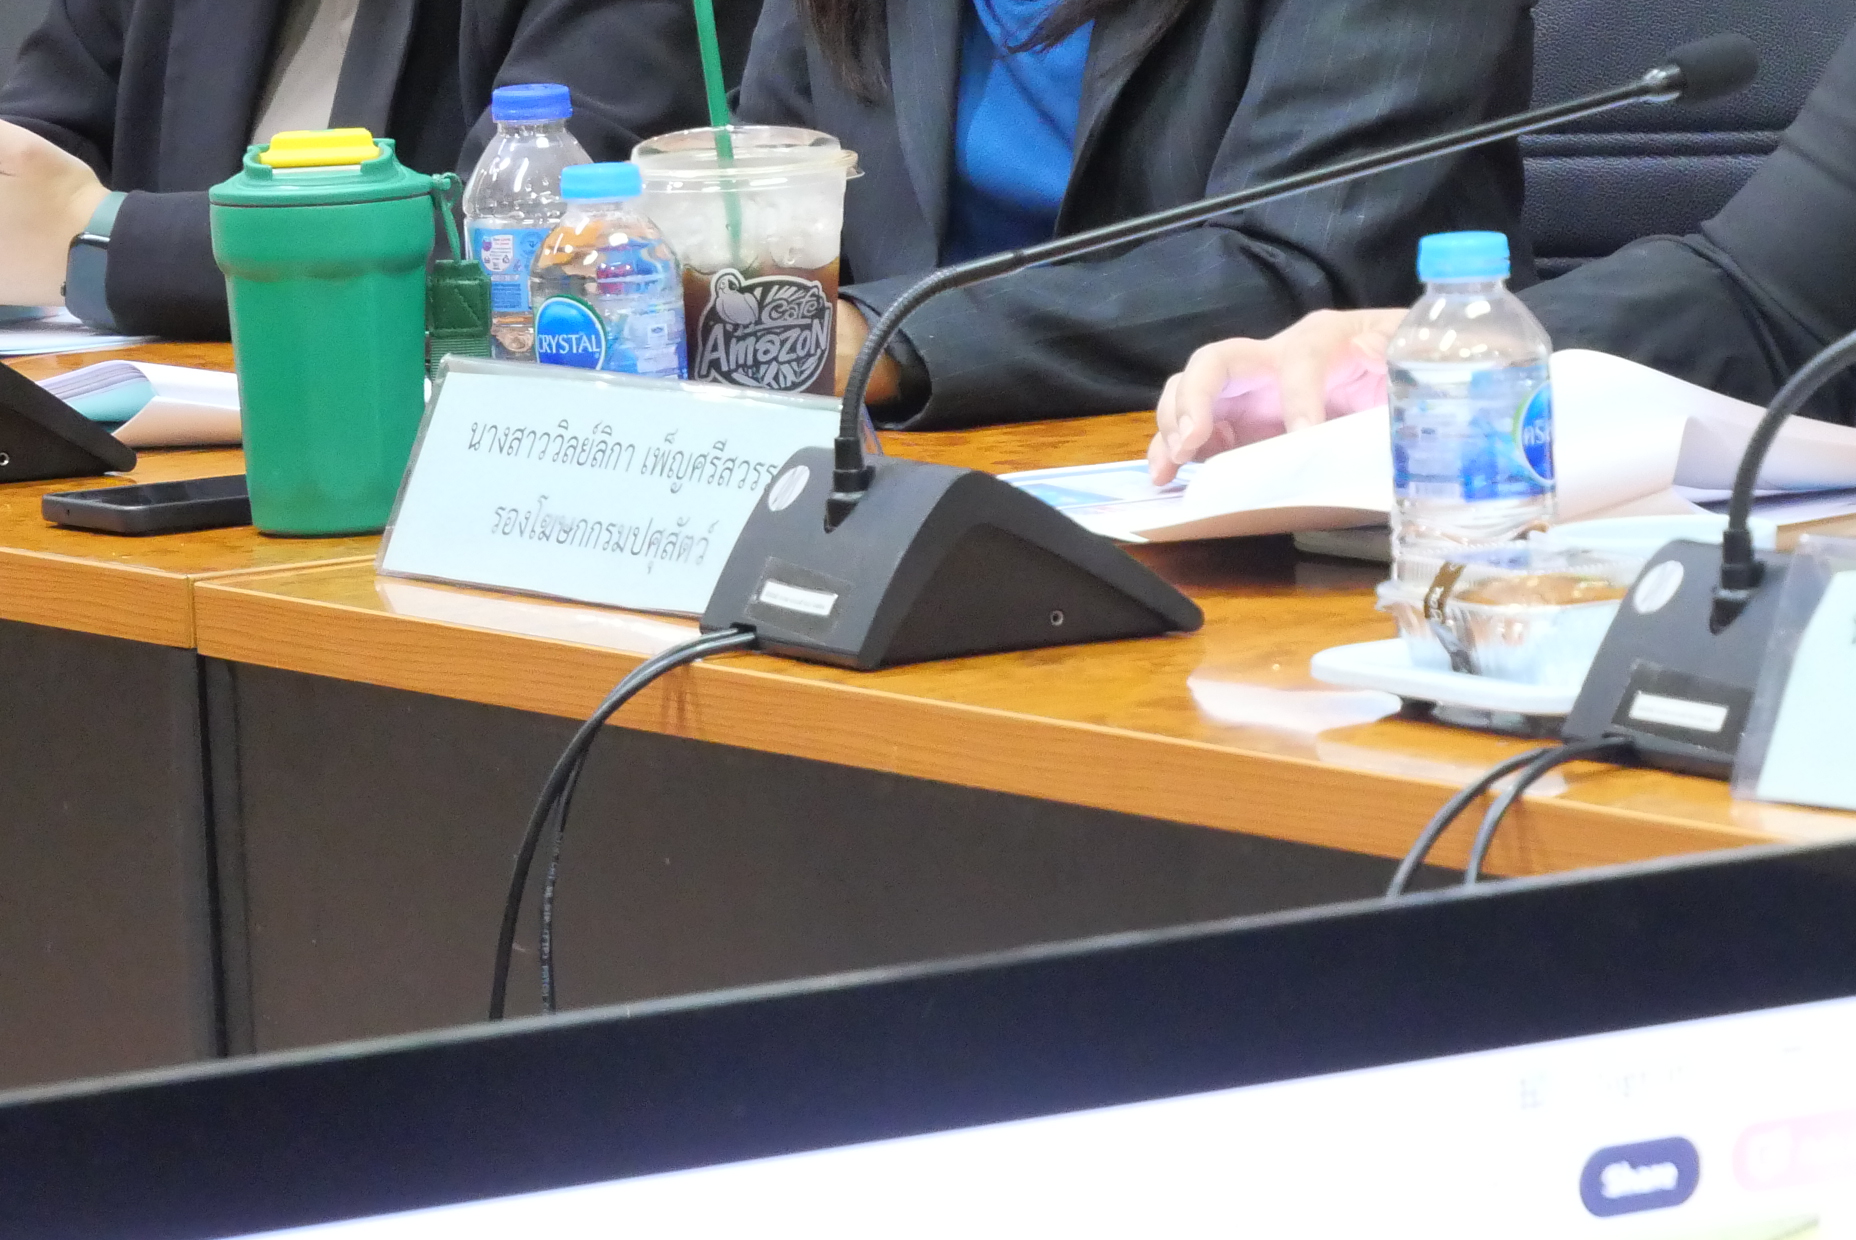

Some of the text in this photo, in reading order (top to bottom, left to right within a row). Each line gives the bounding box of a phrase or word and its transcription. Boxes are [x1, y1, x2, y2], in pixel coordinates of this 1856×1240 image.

[538, 334, 600, 355] CRYSTAL
[468, 418, 636, 473] นางสาววิลย์ลิกา
[491, 494, 719, 575] รองโฆษกกรมปศุสัตว์
